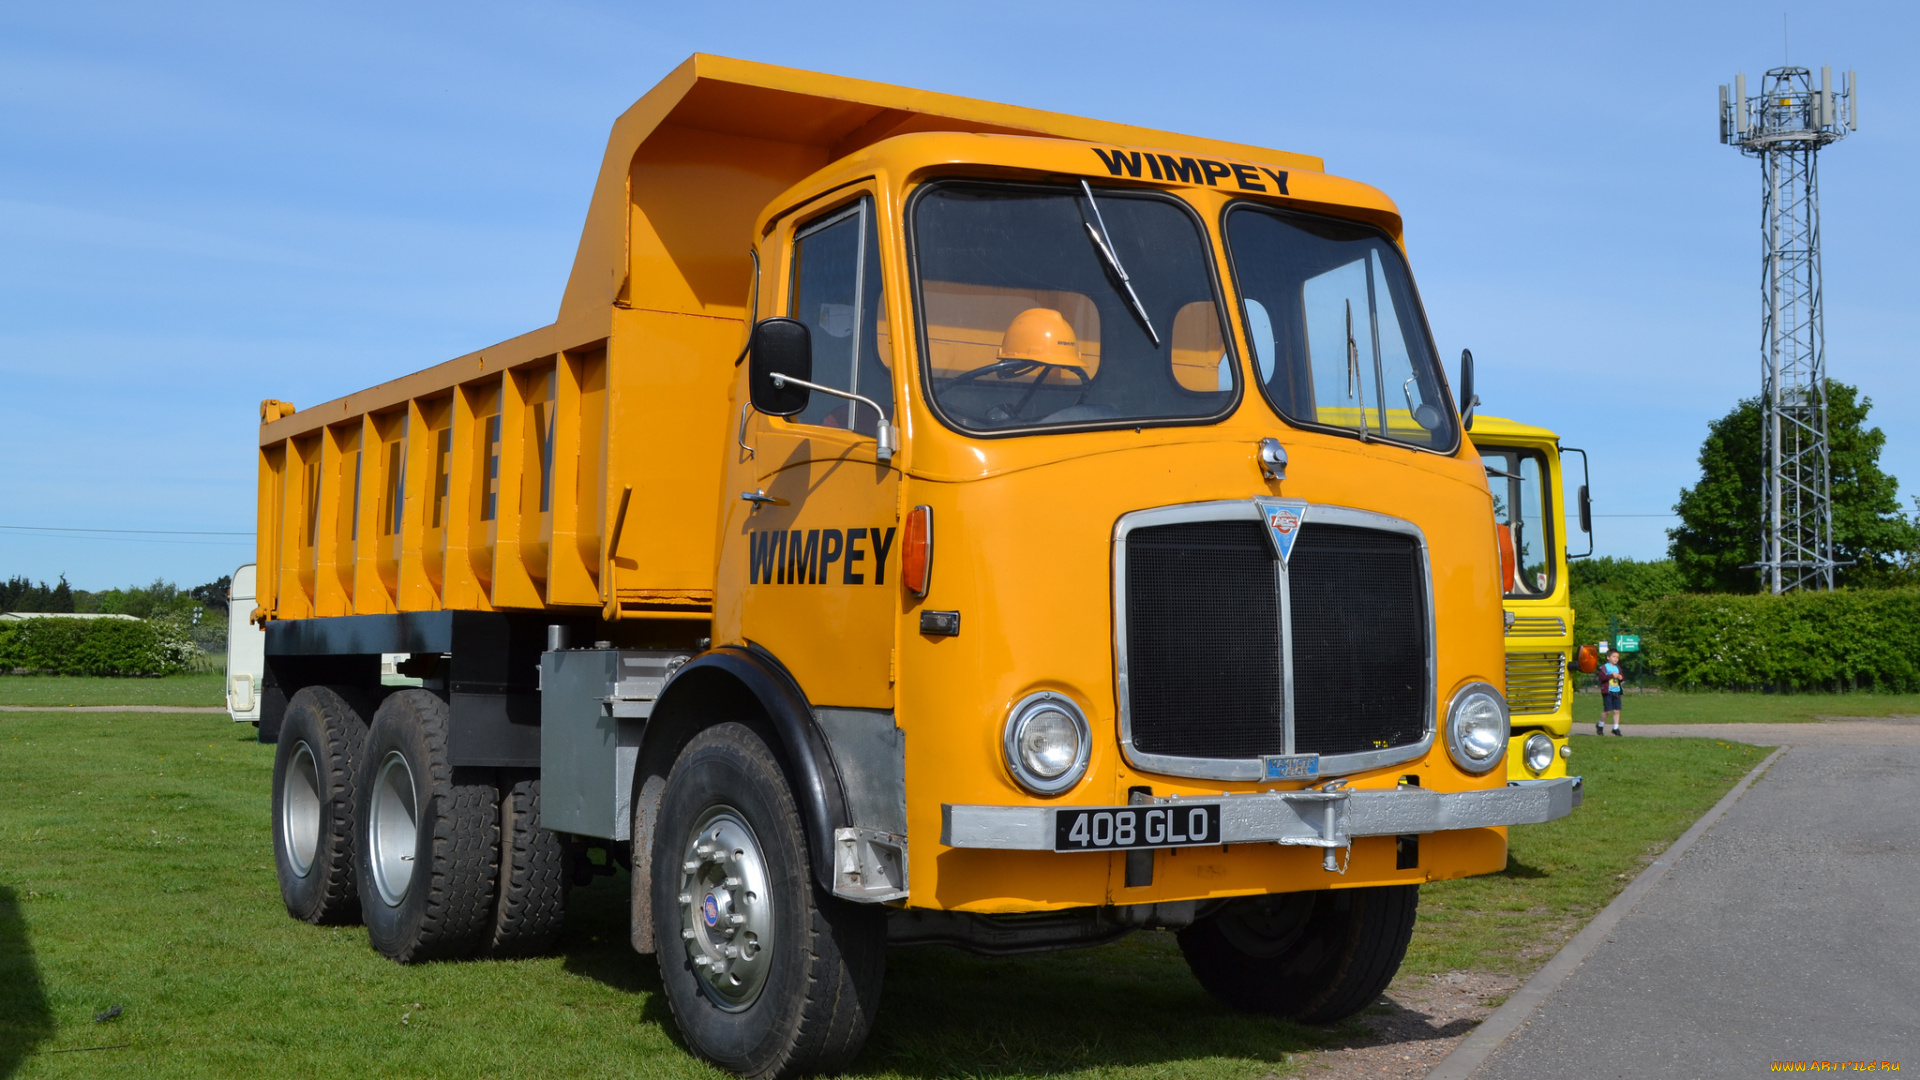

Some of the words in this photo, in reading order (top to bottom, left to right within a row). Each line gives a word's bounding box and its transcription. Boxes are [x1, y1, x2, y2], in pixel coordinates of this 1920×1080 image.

[1090, 147, 1290, 196] WIMPEY
[749, 527, 897, 585] WIMPEY
[1068, 811, 1136, 847] 408
[1145, 808, 1208, 844] GLO
